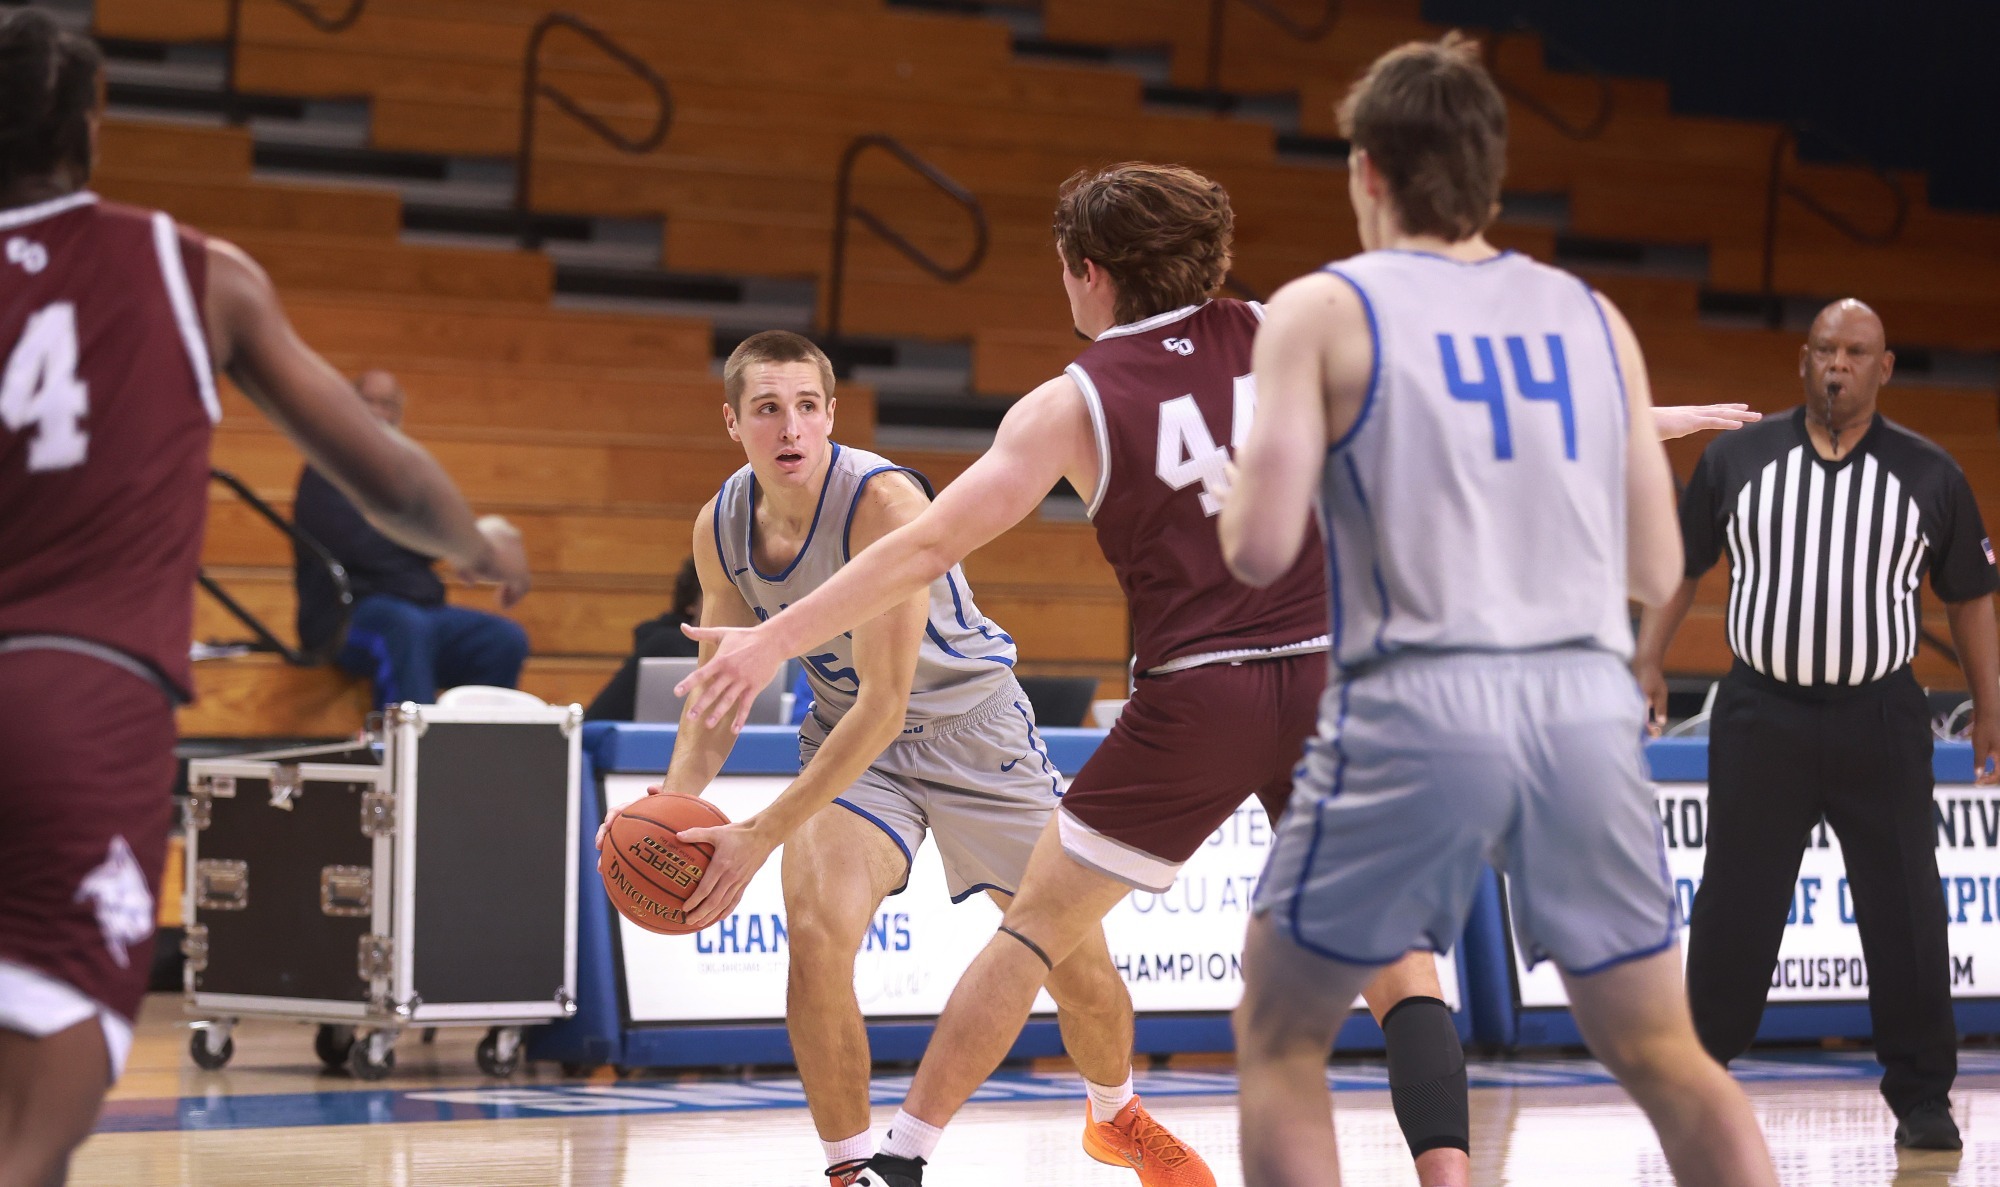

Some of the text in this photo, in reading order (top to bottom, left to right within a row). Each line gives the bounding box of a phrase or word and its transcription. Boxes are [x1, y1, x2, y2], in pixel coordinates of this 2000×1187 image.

[0, 302, 88, 473] 4
[1436, 333, 1577, 461] 44
[629, 842, 699, 888] EGACY
